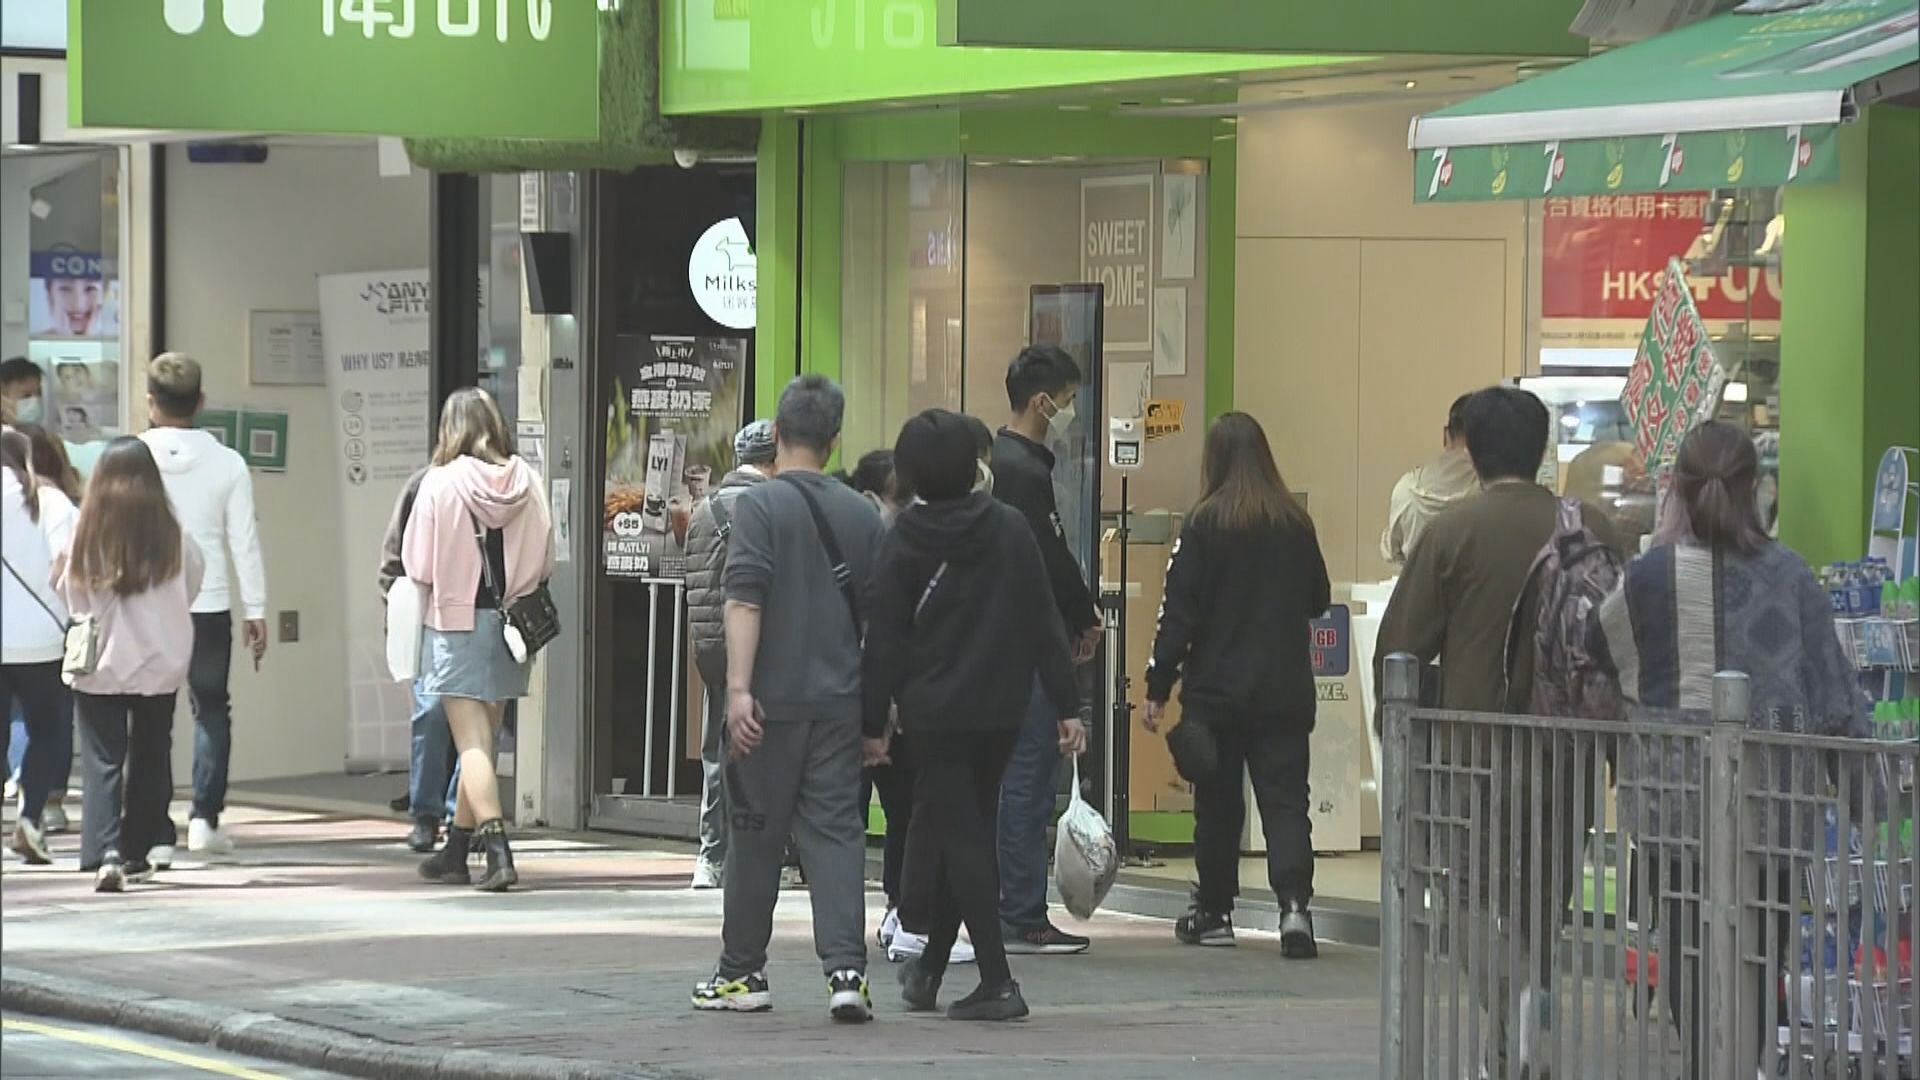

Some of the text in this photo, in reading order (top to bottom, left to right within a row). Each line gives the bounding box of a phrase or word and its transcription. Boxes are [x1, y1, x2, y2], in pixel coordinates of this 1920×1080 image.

[1087, 219, 1146, 257] SWEET
[341, 353, 368, 371] WHY
[371, 351, 393, 370] US?
